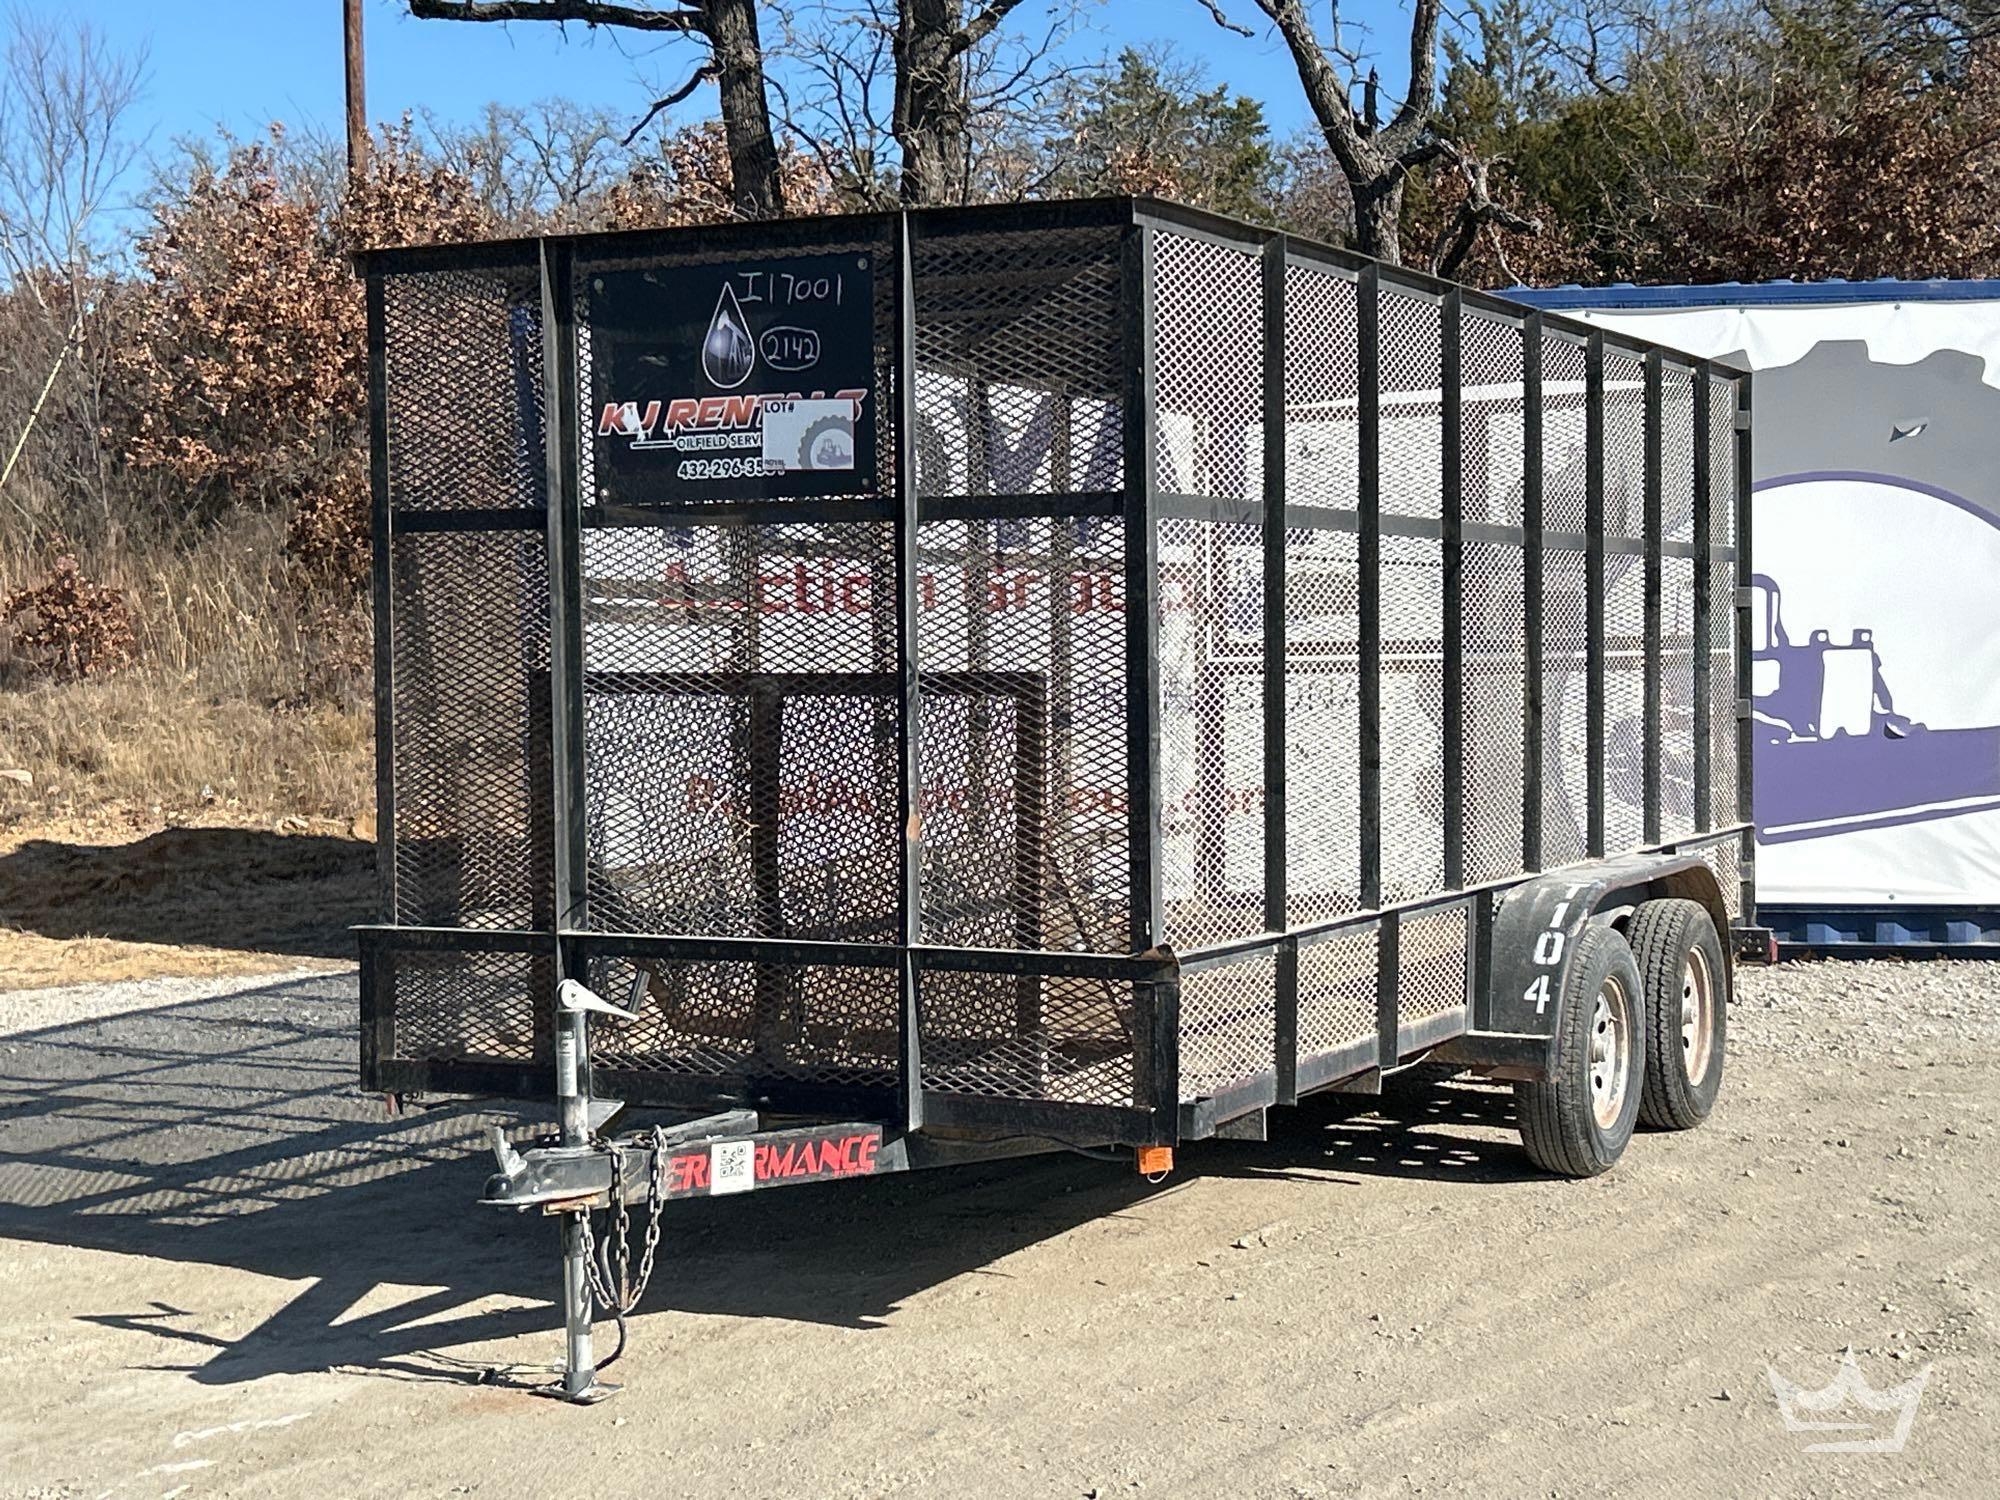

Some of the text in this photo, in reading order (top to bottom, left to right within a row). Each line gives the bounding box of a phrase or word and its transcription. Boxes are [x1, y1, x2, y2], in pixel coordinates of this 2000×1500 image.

[766, 335, 817, 361] 2142
[664, 389, 868, 431] RENTS
[764, 402, 796, 414] LOT#
[676, 435, 728, 451] OILFIELD
[678, 457, 785, 479] 432-296-35
[664, 1133, 880, 1191] ERRMANCE
